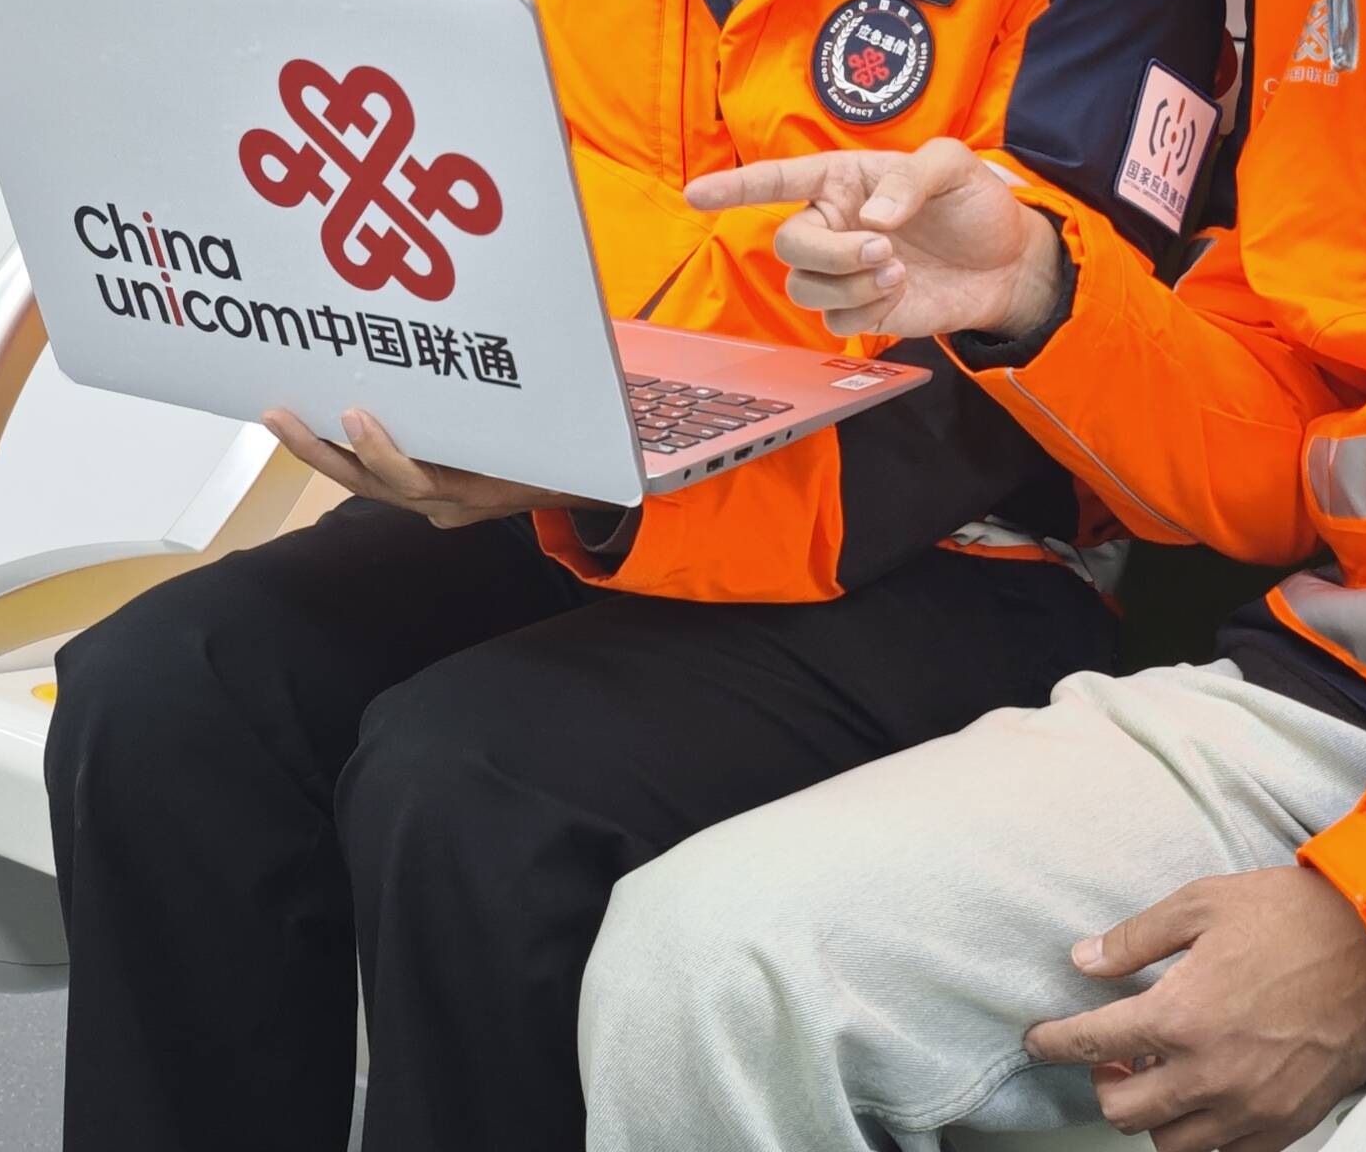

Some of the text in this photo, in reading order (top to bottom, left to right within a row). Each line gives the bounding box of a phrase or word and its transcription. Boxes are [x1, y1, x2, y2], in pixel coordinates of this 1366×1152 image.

[821, 41, 833, 83] Unicom
[827, 86, 873, 118] Emergency
[880, 42, 928, 113] Communication
[855, 24, 908, 57] 应急通信
[73, 202, 242, 281] China
[95, 271, 311, 351] unicom
[307, 305, 522, 390] 中国联通
